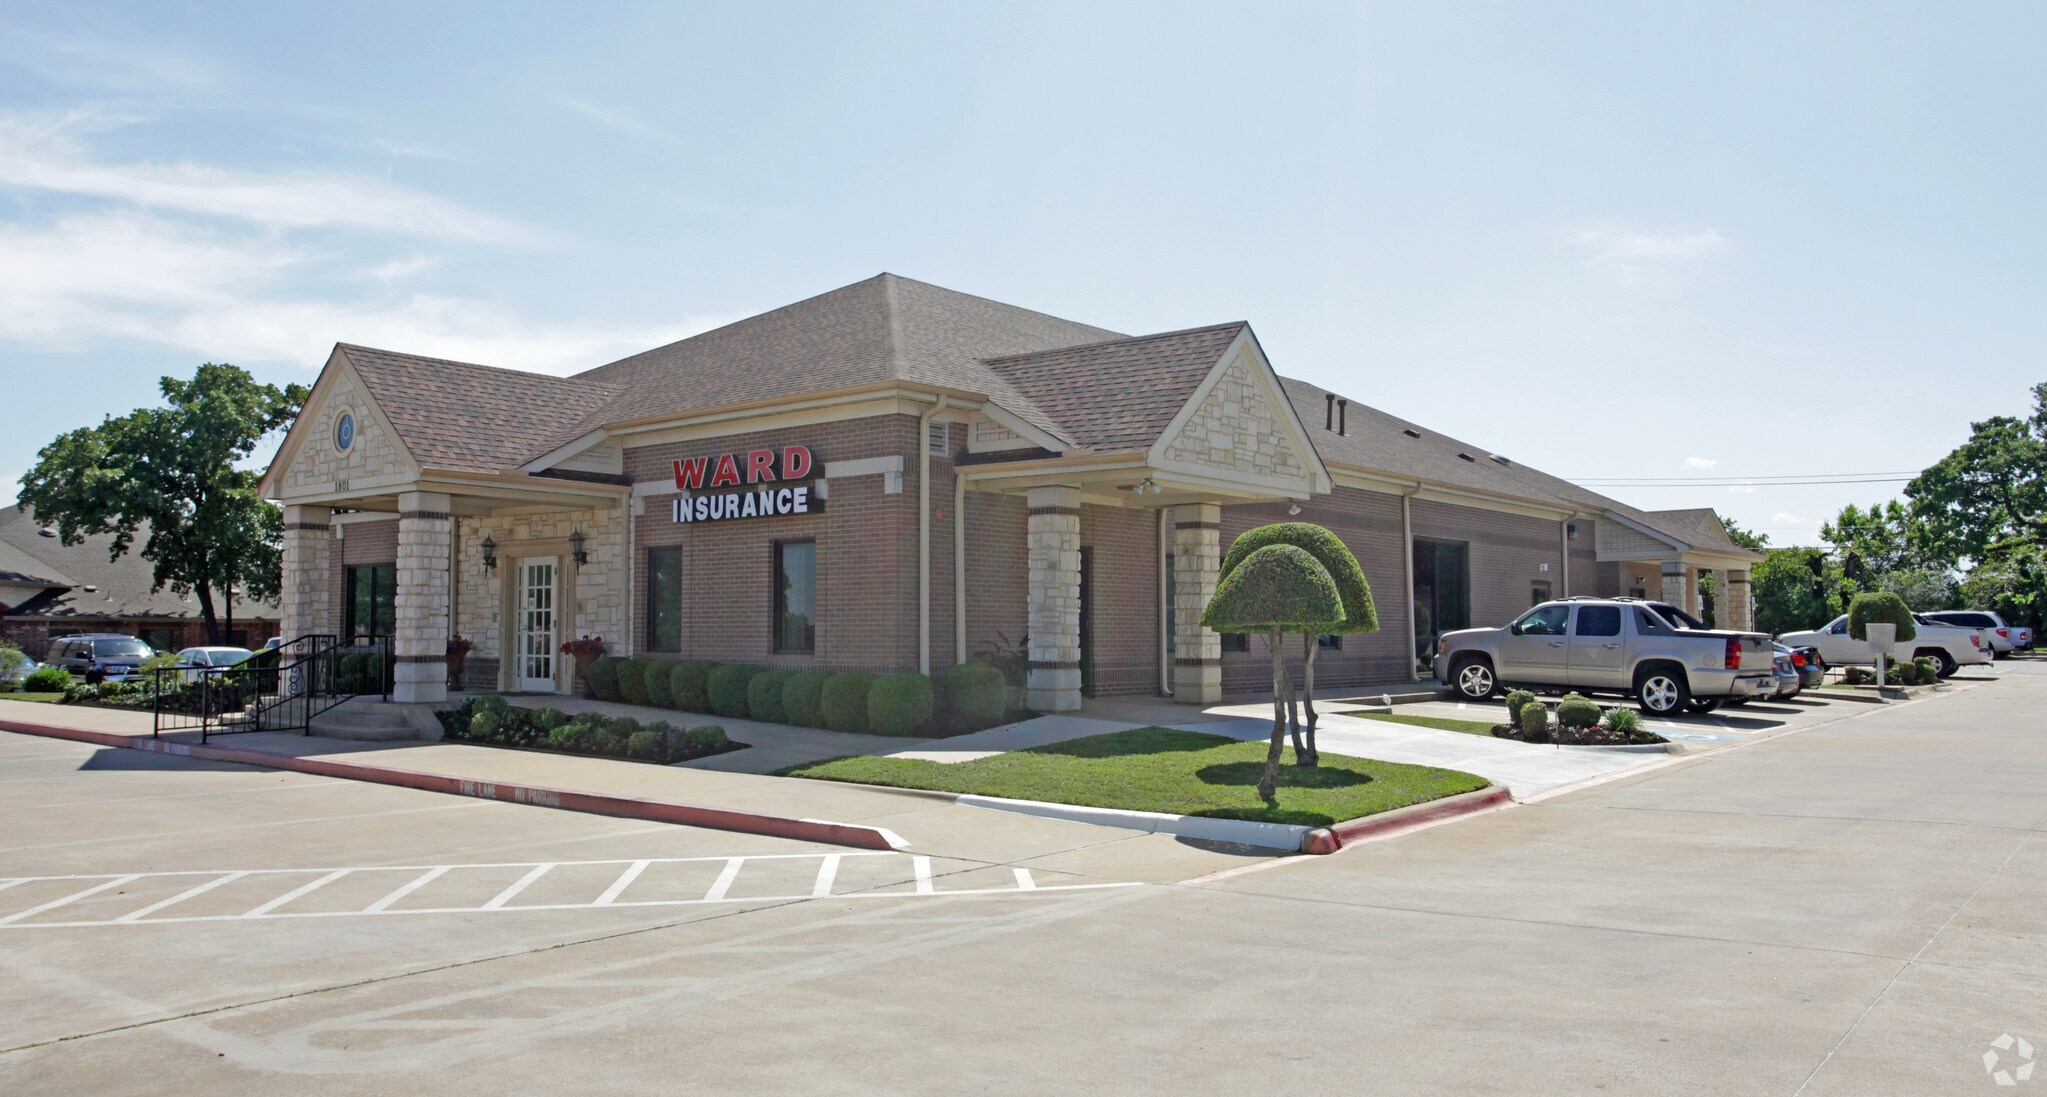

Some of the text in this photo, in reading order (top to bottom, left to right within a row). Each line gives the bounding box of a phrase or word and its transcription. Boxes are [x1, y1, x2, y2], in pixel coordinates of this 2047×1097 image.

[672, 446, 812, 490] WARD
[334, 480, 350, 492] 1801
[672, 487, 808, 523] INSURANCE
[459, 780, 560, 806] FIRE LANE NO PARKING
